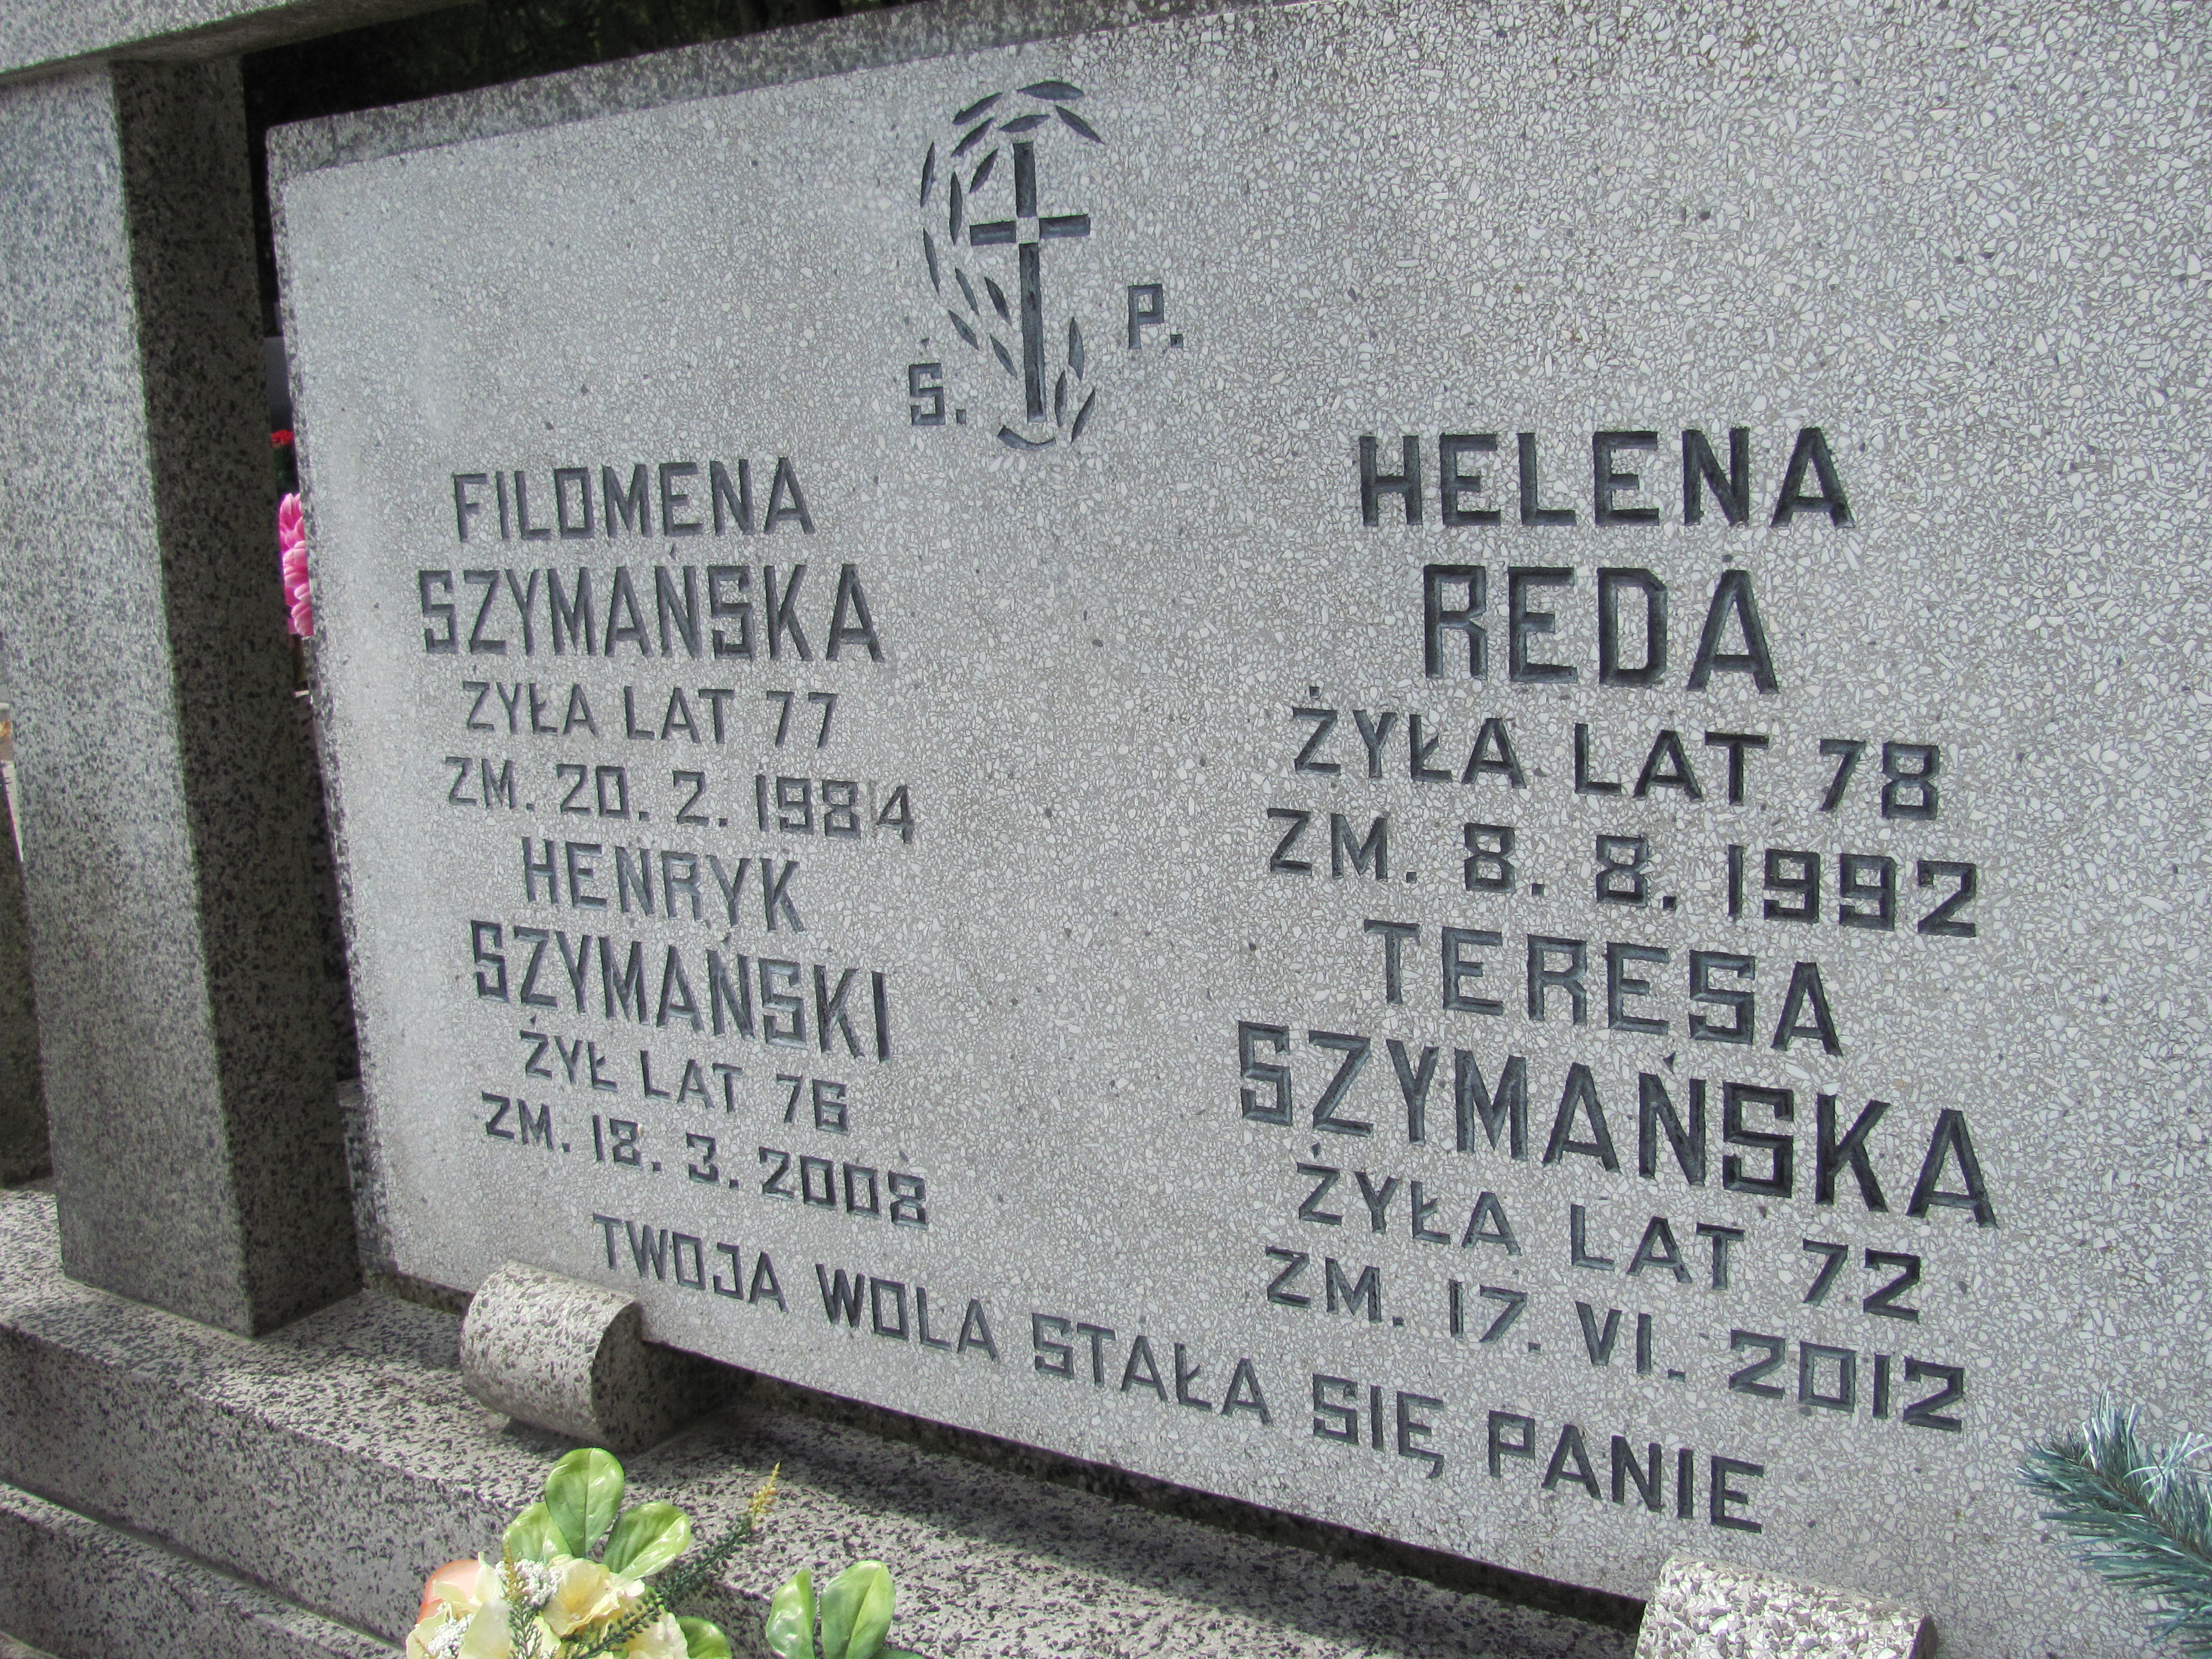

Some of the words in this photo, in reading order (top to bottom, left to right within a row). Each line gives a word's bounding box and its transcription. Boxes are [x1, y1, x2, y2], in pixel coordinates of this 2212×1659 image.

[1128, 283, 1184, 349] P.
[454, 457, 816, 543] FILOMENA
[1358, 427, 1856, 529] HELENA
[418, 544, 885, 663] SZYMAŃSKA
[1423, 564, 1780, 694] REDA
[624, 686, 736, 745] LAT
[766, 690, 838, 748] 77
[1292, 686, 1527, 789] ŻYŁA
[1575, 723, 1769, 806] LAT
[1820, 739, 1941, 820] 78
[445, 756, 535, 811] ZM.
[556, 763, 650, 821] 20.
[672, 770, 728, 828] 2.
[756, 774, 914, 845] 1984
[521, 836, 806, 934] HENRYK
[1267, 807, 1418, 884] ZM.
[1464, 822, 1544, 896] 8.
[1595, 834, 1677, 910] 8.
[1728, 845, 1978, 939] 1992
[470, 920, 891, 1062] SZYMAŃSKI
[1363, 919, 1843, 1057] TERESA
[519, 1015, 618, 1092] ŻYŁ
[640, 1050, 743, 1113] LAT
[776, 1073, 850, 1136] 76
[1238, 1020, 1998, 1228] SZYMAŃSKA
[481, 1091, 572, 1153] ZM.
[592, 1114, 663, 1173] 18.
[685, 1133, 740, 1189] 3.
[758, 1146, 929, 1230] 2008
[1296, 1142, 1523, 1256] ŻYŁA
[1570, 1204, 1745, 1290] LAT
[1801, 1238, 1922, 1322] 72
[594, 1213, 788, 1313] TWOJA
[815, 1263, 1000, 1362] WOLA
[1032, 1310, 1274, 1423] STAŁA
[1312, 1372, 1445, 1480] SIĘ
[1488, 1408, 1765, 1535] PANIE
[1264, 1245, 1406, 1326] ZM.
[1449, 1278, 1542, 1353] 17.
[1575, 1301, 1686, 1382] VI.
[1729, 1330, 1966, 1433] 2012
